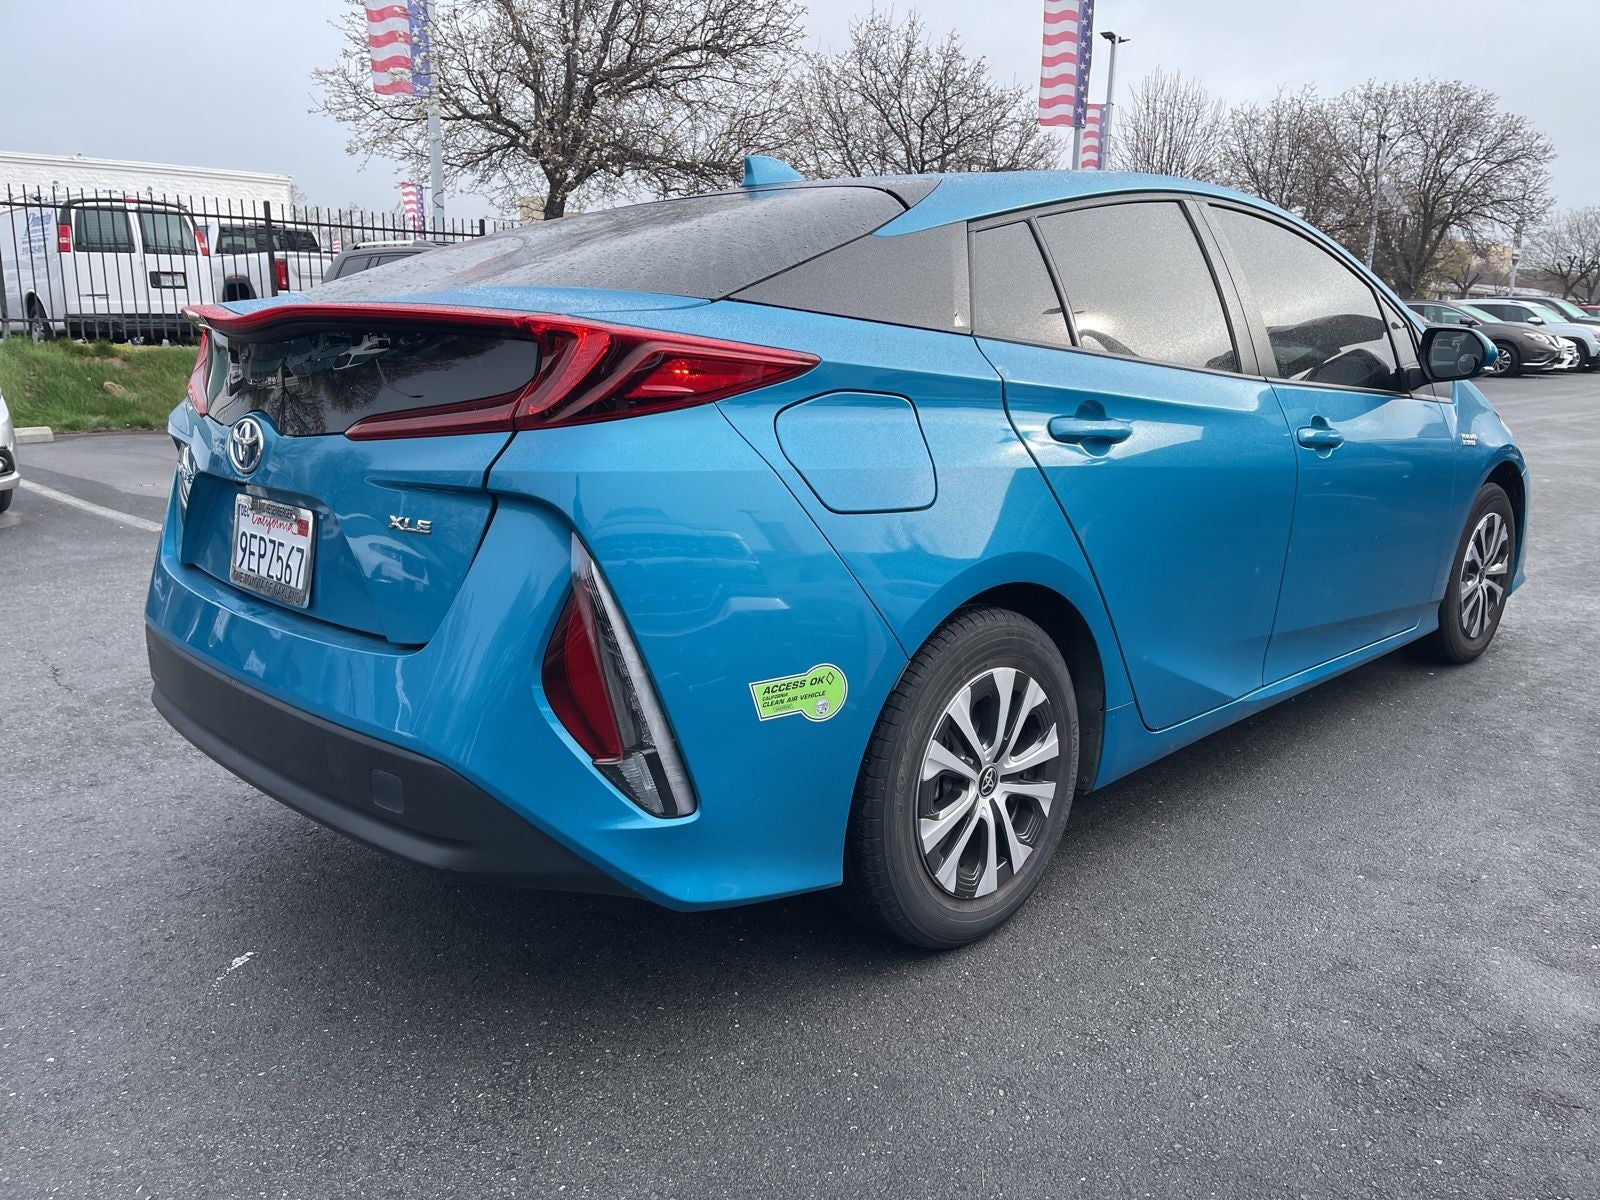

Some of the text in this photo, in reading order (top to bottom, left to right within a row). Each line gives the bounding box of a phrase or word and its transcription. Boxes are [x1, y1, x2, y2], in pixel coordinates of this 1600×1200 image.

[389, 514, 432, 534] XLE
[238, 530, 305, 588] 9EPZ567
[762, 676, 826, 695] ACCESS OK
[762, 692, 789, 702] CALIFORNIA
[762, 699, 784, 708] CLEAN
[800, 690, 826, 701] VEHICLE
